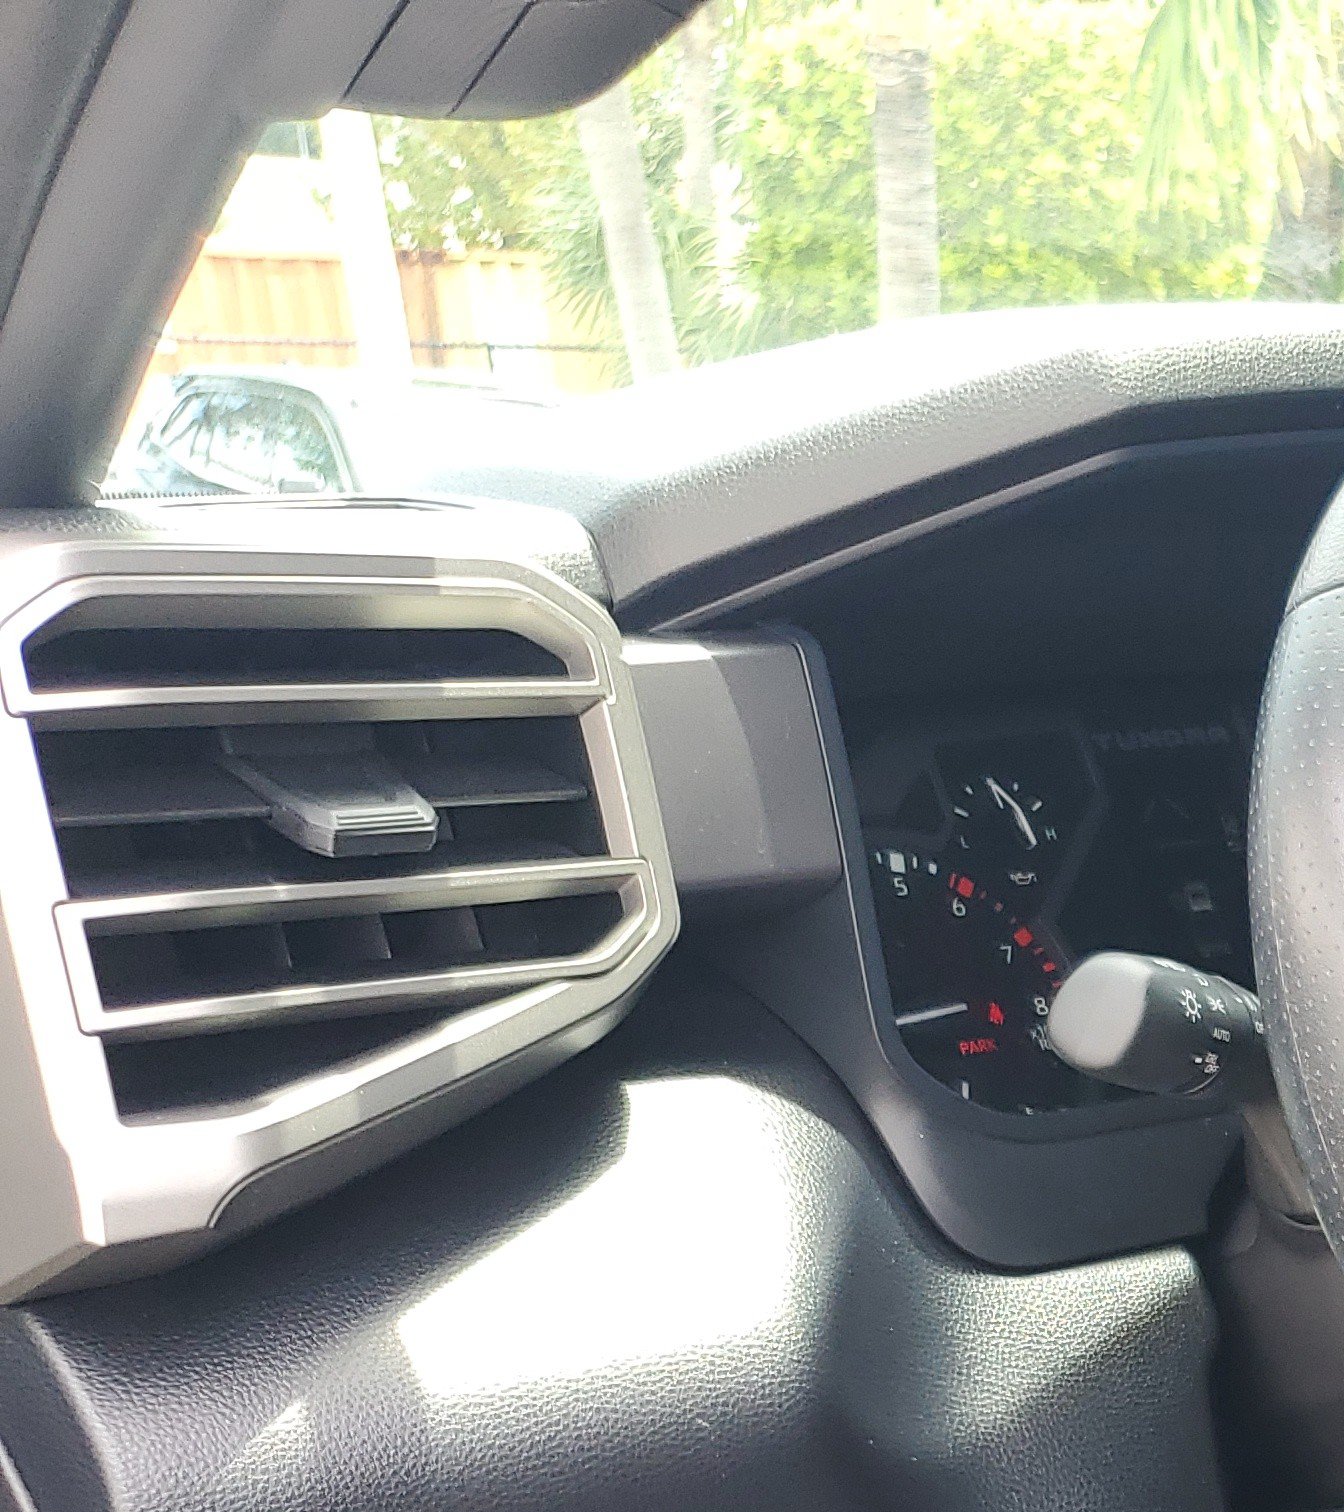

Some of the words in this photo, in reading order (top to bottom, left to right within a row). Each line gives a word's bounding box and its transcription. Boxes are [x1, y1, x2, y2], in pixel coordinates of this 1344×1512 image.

[893, 876, 908, 897] 5
[953, 897, 967, 917] 6
[1000, 944, 1013, 964] 7
[1034, 997, 1049, 1015] 8
[1212, 1027, 1232, 1043] AUTO
[959, 1037, 998, 1056] PARK
